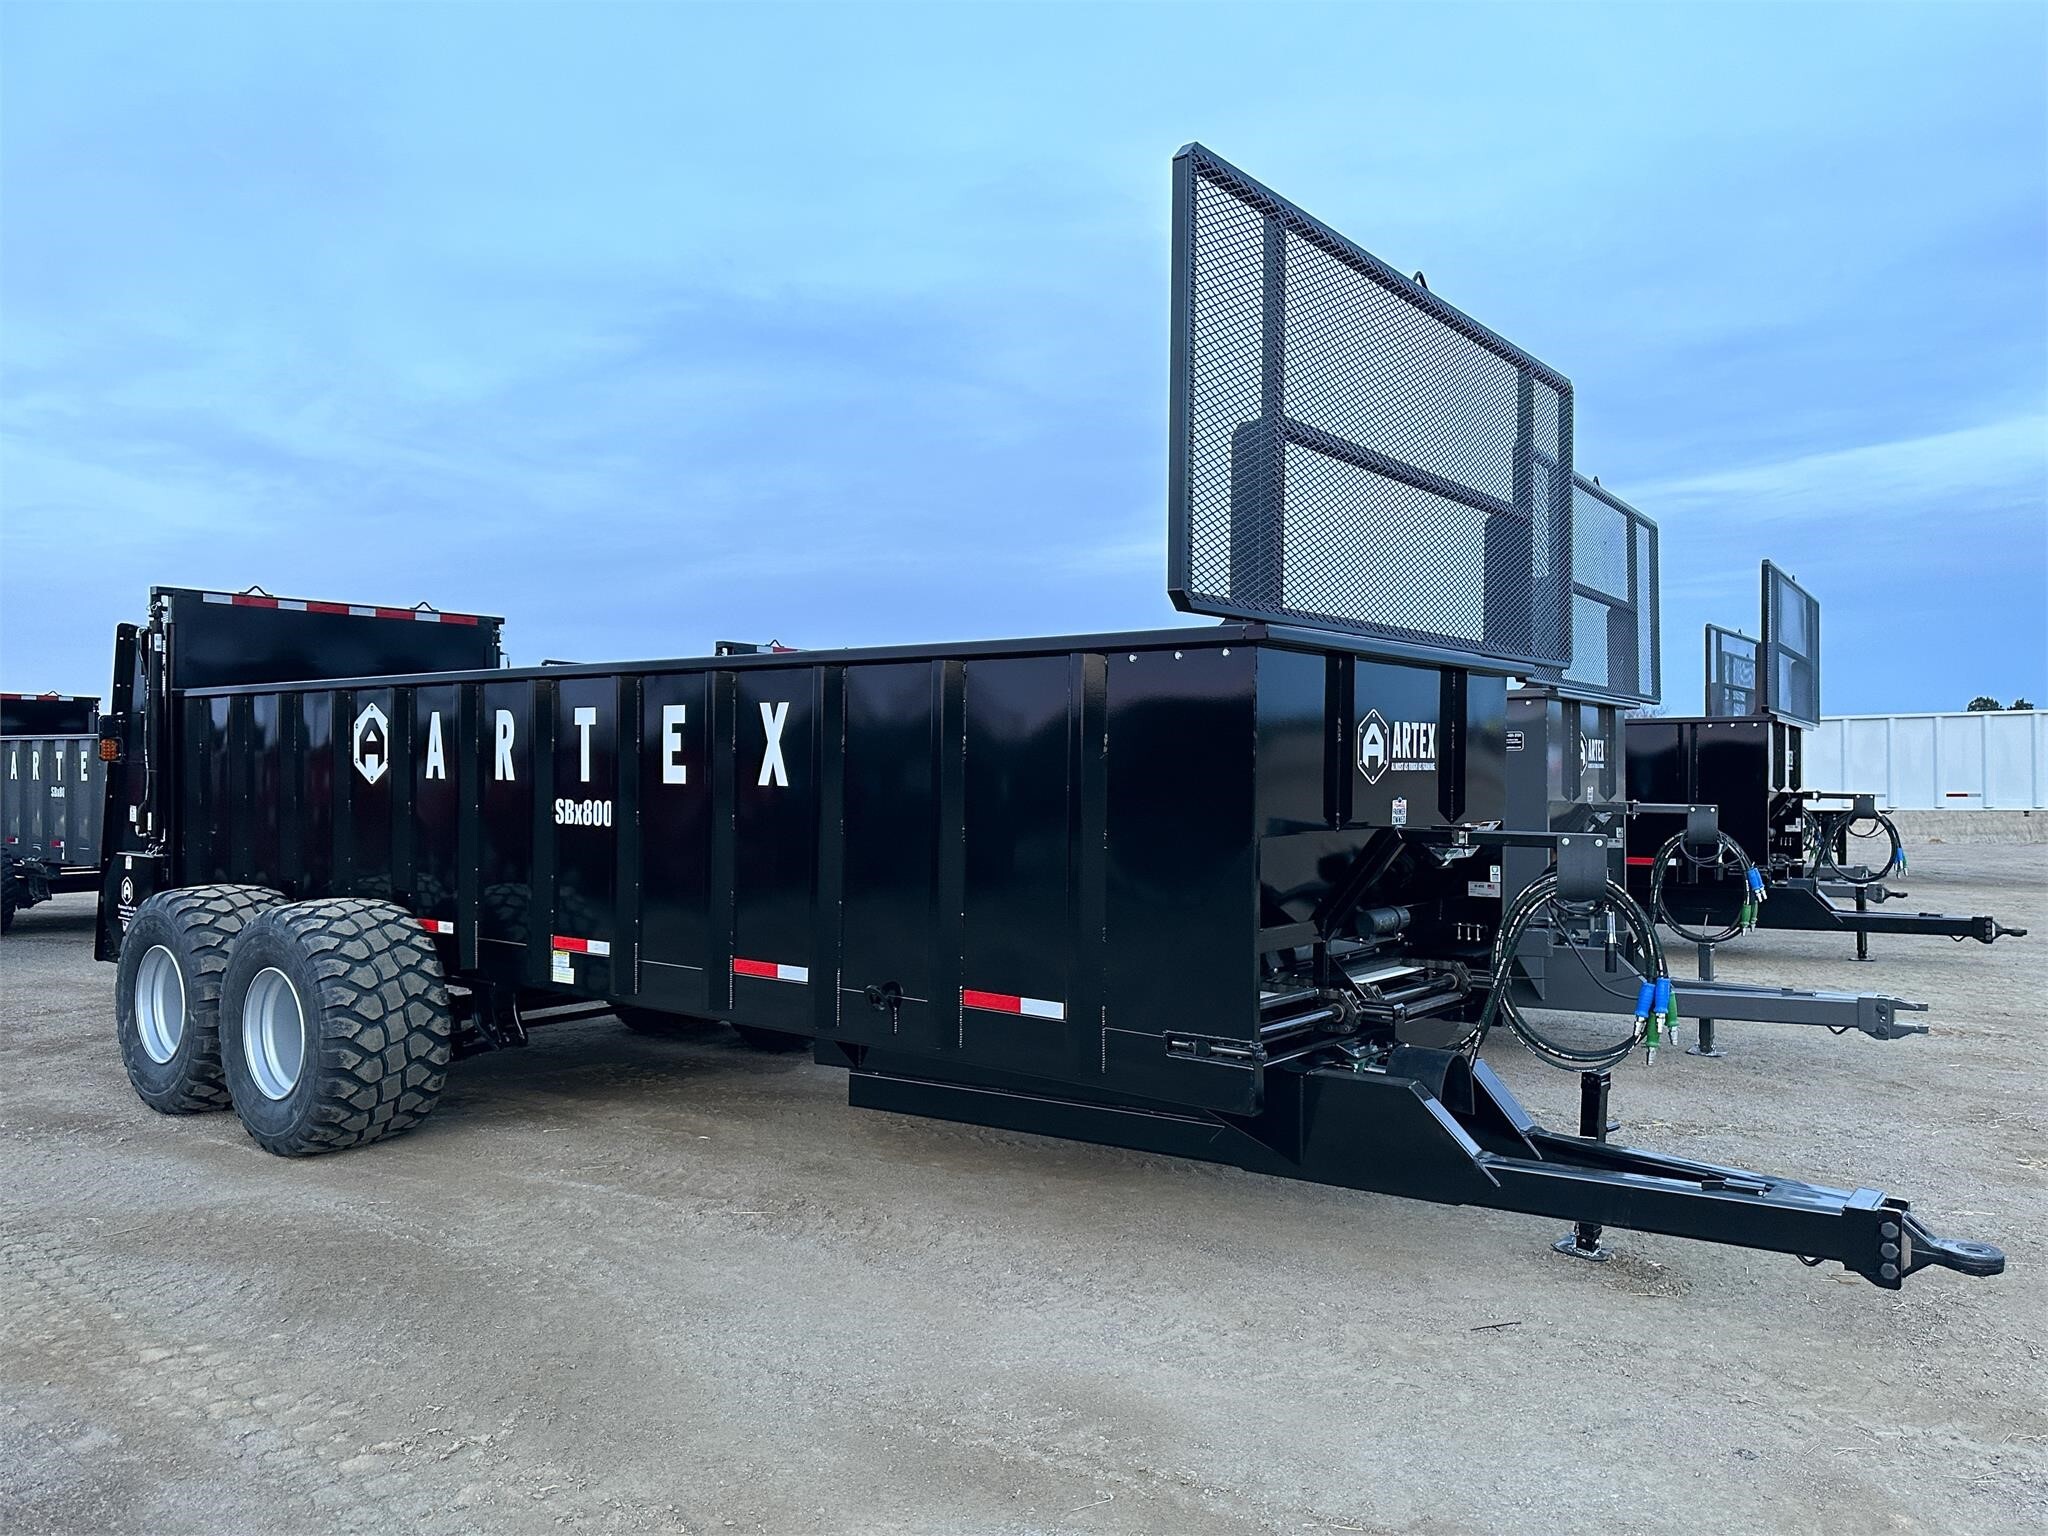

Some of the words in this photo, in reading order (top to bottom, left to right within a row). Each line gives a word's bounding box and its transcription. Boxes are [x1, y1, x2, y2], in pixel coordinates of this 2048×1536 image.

[1392, 722, 1436, 759] ARTEX
[1588, 739, 1605, 762] ARTEX
[11, 751, 108, 782] ARTE
[555, 798, 612, 827] SBx800
